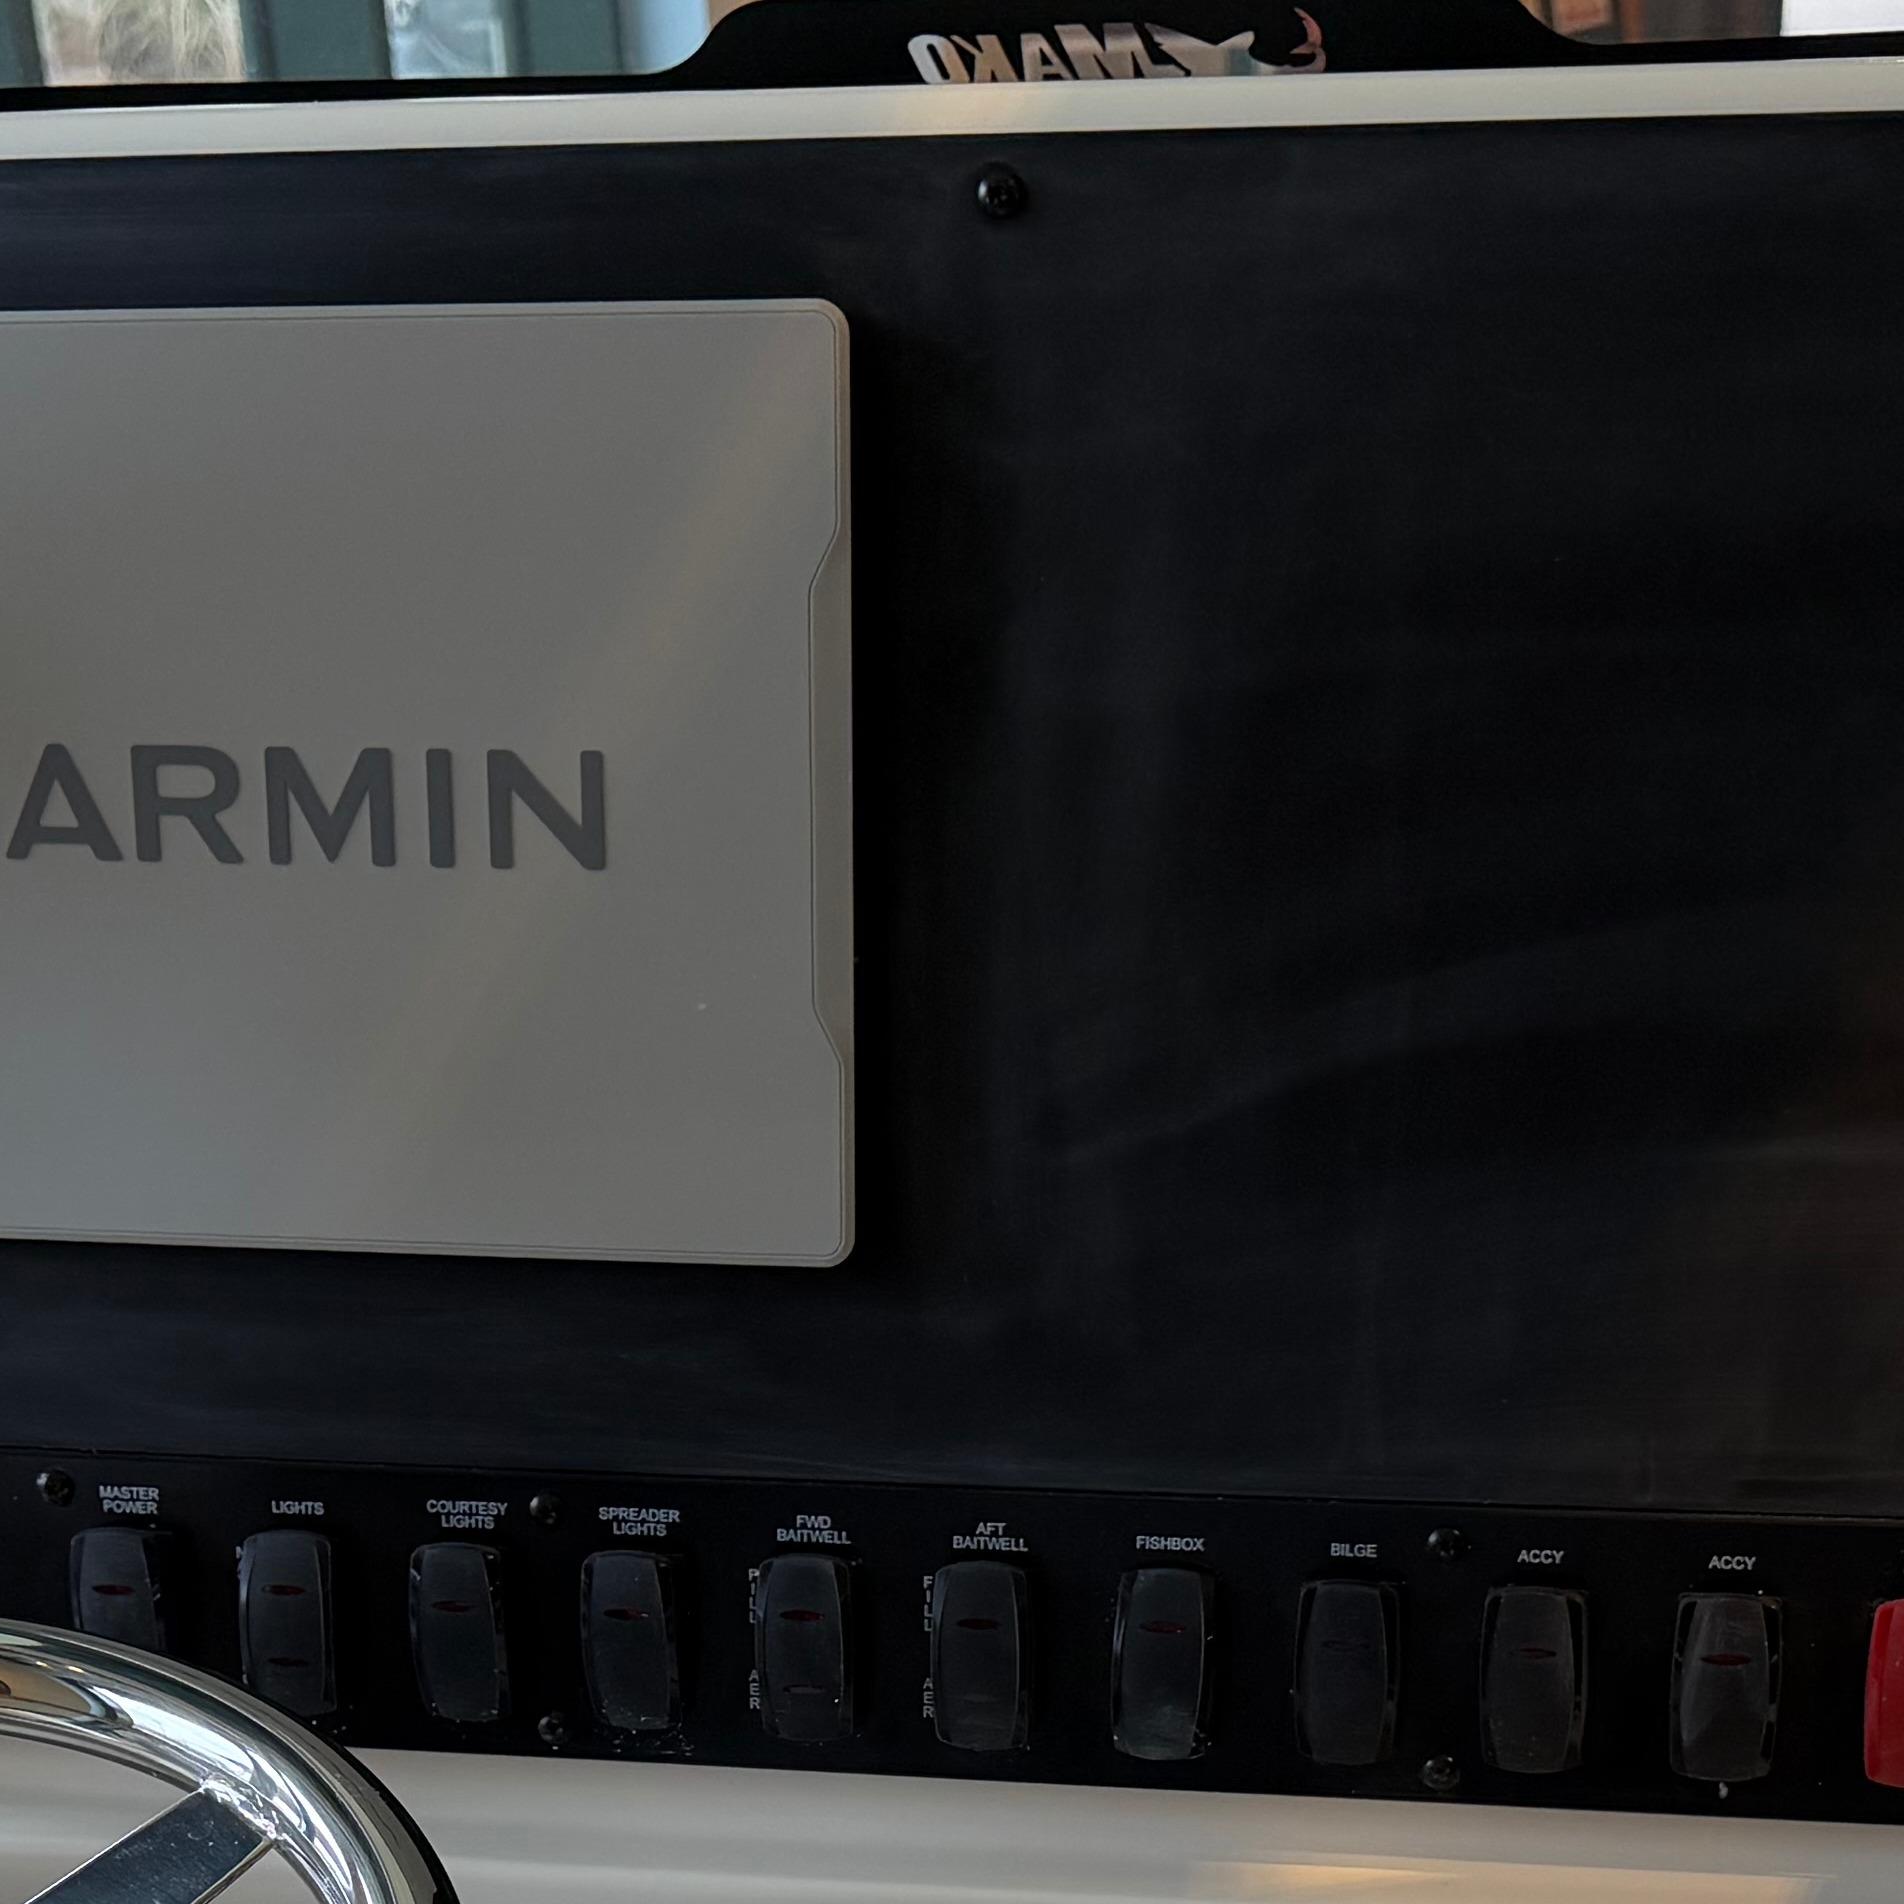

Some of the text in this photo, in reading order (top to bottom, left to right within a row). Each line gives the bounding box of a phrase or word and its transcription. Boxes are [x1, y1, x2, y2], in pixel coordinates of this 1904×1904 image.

[99, 1485, 160, 1502] MASTER
[102, 1498, 159, 1515] POWER
[271, 1500, 325, 1516] LIGHTS
[426, 1499, 508, 1518] COURTESY
[598, 1506, 680, 1524] SPREADER
[441, 1513, 497, 1530] LIGHTS
[612, 1520, 668, 1537] LIGHTS
[795, 1514, 832, 1529] FWD
[975, 1521, 1007, 1537] AFT
[776, 1528, 851, 1545] BAITWELL
[952, 1536, 1029, 1552] BAITWELL
[1135, 1535, 1205, 1552] FISHBOX
[1330, 1542, 1378, 1559] BILGE
[1517, 1549, 1564, 1565] ACCY
[1708, 1555, 1756, 1571] ACCY
[748, 1669, 761, 1710] AER
[922, 1678, 934, 1719] AER
